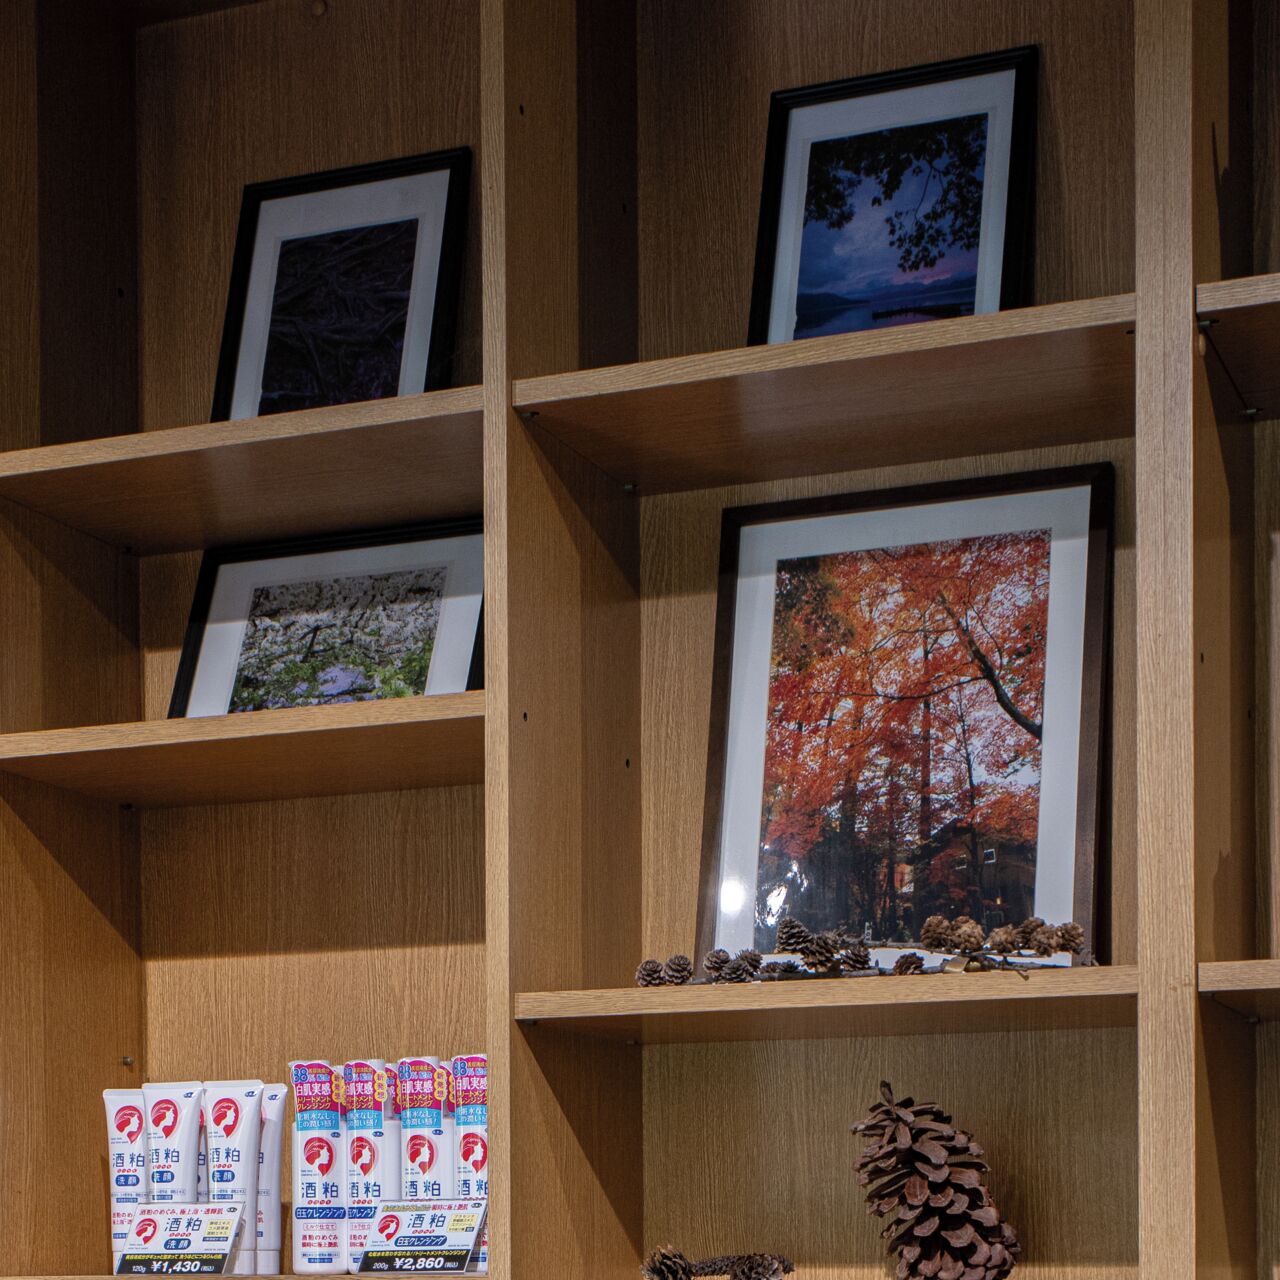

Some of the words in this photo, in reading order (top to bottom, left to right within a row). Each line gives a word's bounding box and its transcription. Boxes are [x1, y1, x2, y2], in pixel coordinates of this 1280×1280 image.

[297, 1083, 330, 1096] 白肌実感
[298, 1102, 331, 1110] クレンジング
[113, 1153, 145, 1167] 酒粕
[117, 1176, 138, 1186] 洗顔
[296, 1208, 344, 1217] 白玉クレンジング
[165, 1218, 202, 1232] 酒粕
[408, 1214, 446, 1228] 酒粕
[166, 1239, 189, 1249] 洗顔
[397, 1237, 446, 1245] 白玉クレンジング
[151, 1261, 200, 1272] ¥1,430
[394, 1258, 444, 1270] ¥2,860
